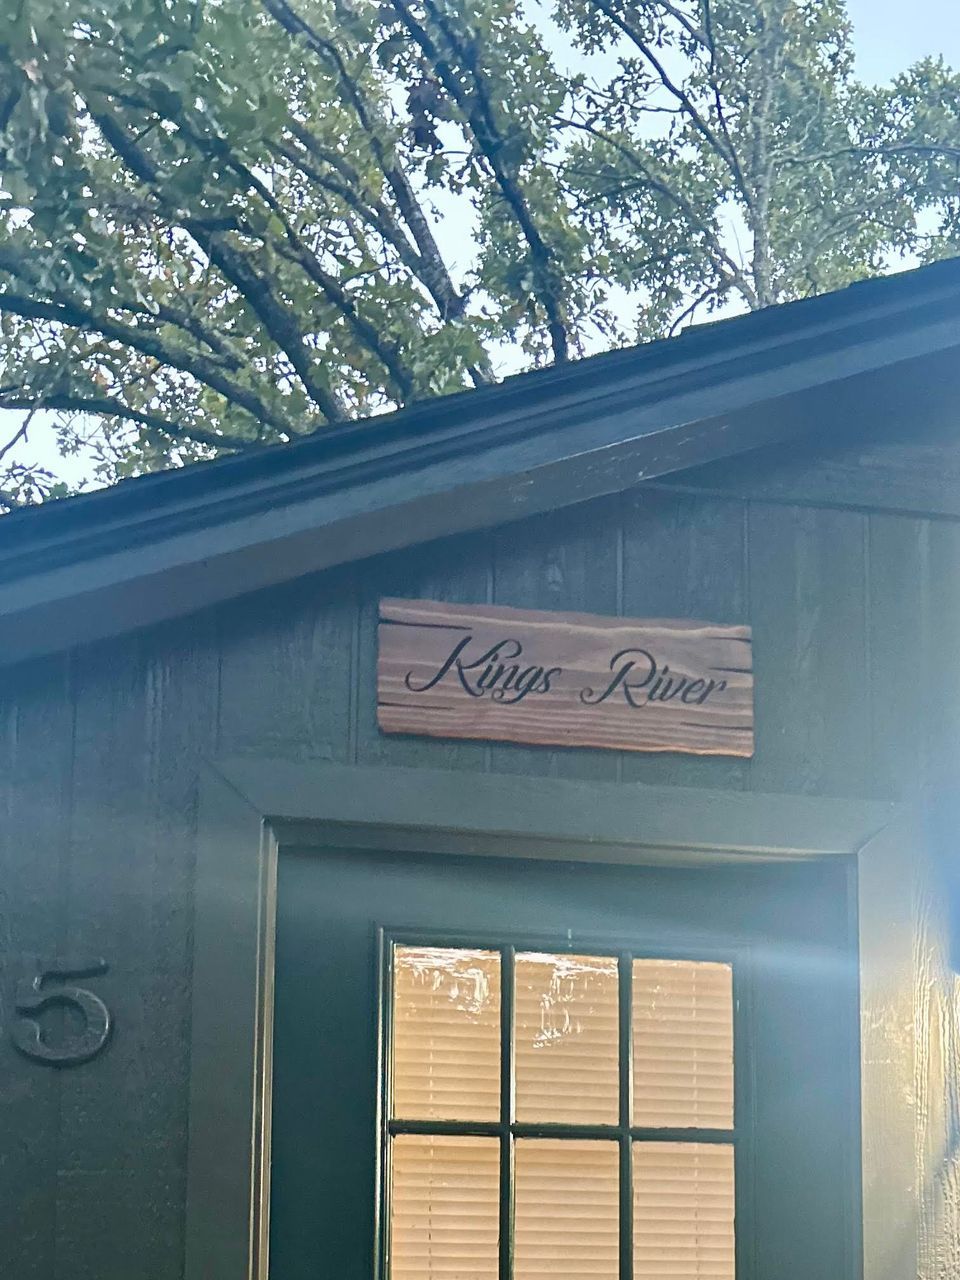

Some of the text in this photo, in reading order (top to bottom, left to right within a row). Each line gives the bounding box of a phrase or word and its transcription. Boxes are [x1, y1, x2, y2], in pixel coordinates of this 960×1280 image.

[404, 635, 727, 709] Kings River
[11, 960, 113, 1067] 5
